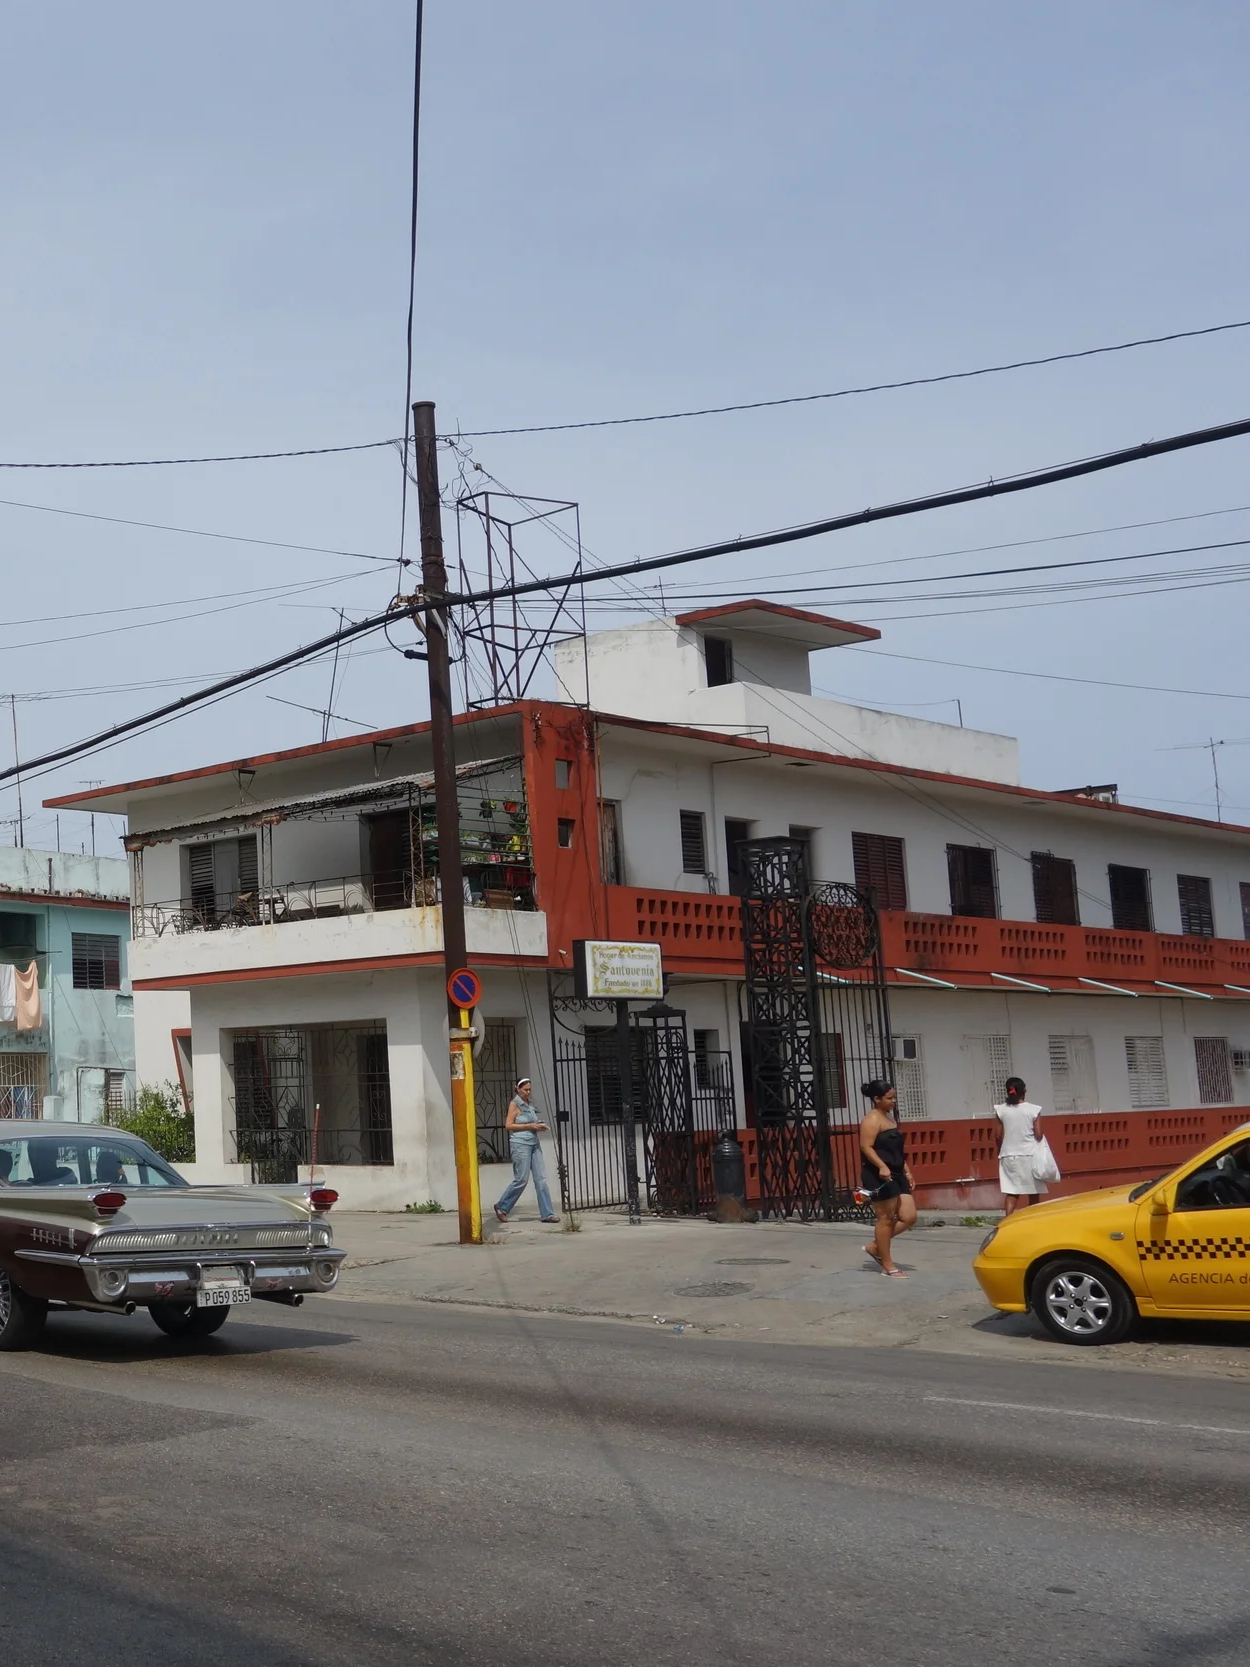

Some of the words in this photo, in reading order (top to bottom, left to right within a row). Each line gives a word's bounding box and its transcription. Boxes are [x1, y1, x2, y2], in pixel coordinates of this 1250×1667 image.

[599, 960, 655, 978] Santovenia
[1168, 1272, 1235, 1284] AGENCIA
[1239, 1272, 1250, 1284] d
[232, 1289, 250, 1303] 855
